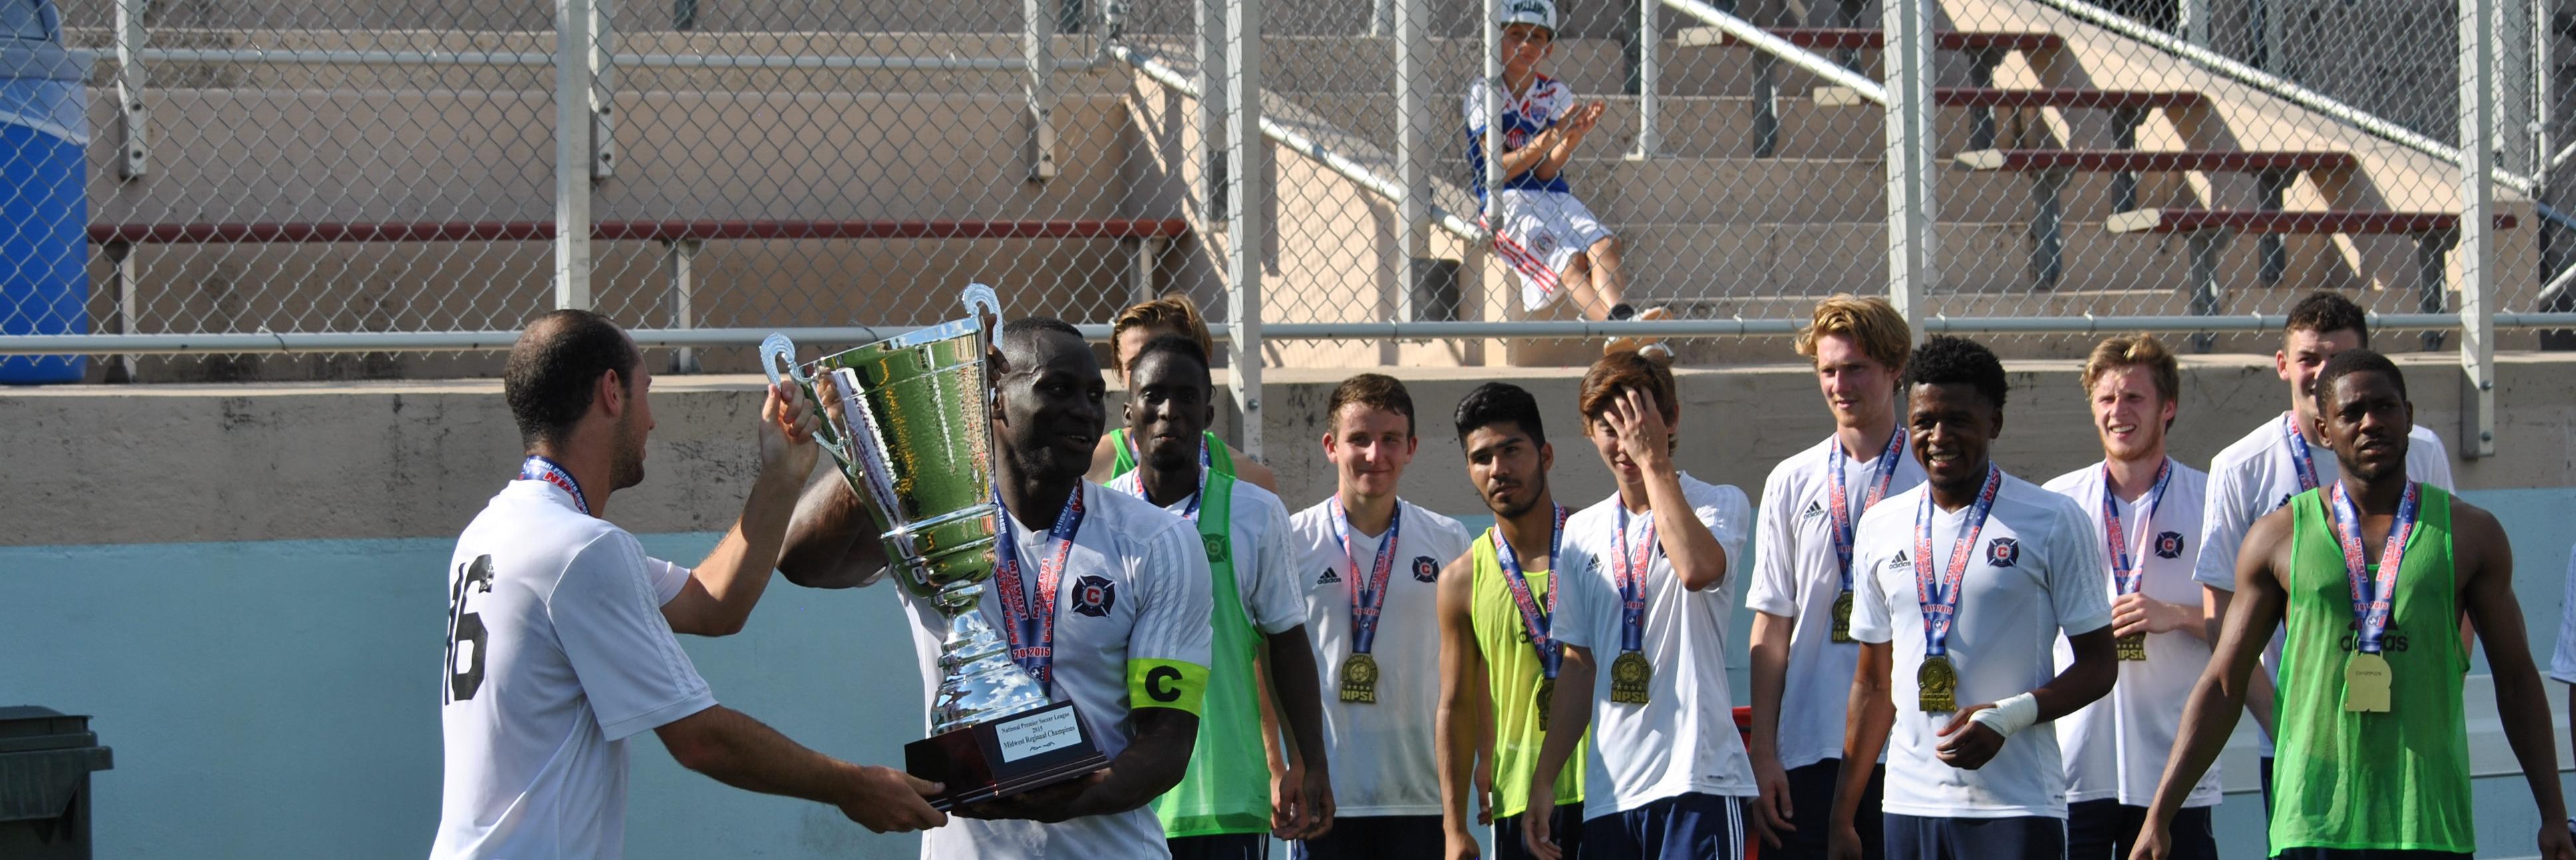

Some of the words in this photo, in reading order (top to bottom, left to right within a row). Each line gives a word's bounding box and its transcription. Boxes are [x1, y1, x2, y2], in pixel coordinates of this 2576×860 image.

[1804, 510, 1825, 519] adidas
[2165, 540, 2174, 550] C
[1998, 546, 2008, 558] C
[1422, 564, 1430, 574] C
[1889, 561, 1911, 570] adidas
[1008, 560, 1029, 621] MIDWEST
[1032, 557, 1049, 619] MIDWEST
[1043, 540, 1072, 643] CHAMPION
[1086, 588, 1100, 603] C
[1935, 604, 1954, 614] 2015
[445, 554, 495, 706] 16
[1029, 647, 1051, 658] 2015
[1145, 665, 1183, 703] C
[1341, 690, 1375, 702] NPSL
[1612, 690, 1647, 702] NPSL
[1001, 724, 1021, 734] National
[1021, 720, 1038, 729] Premier
[1003, 739, 1025, 748] Midwest
[1025, 733, 1047, 744] Regional
[1047, 726, 1076, 737] Champions
